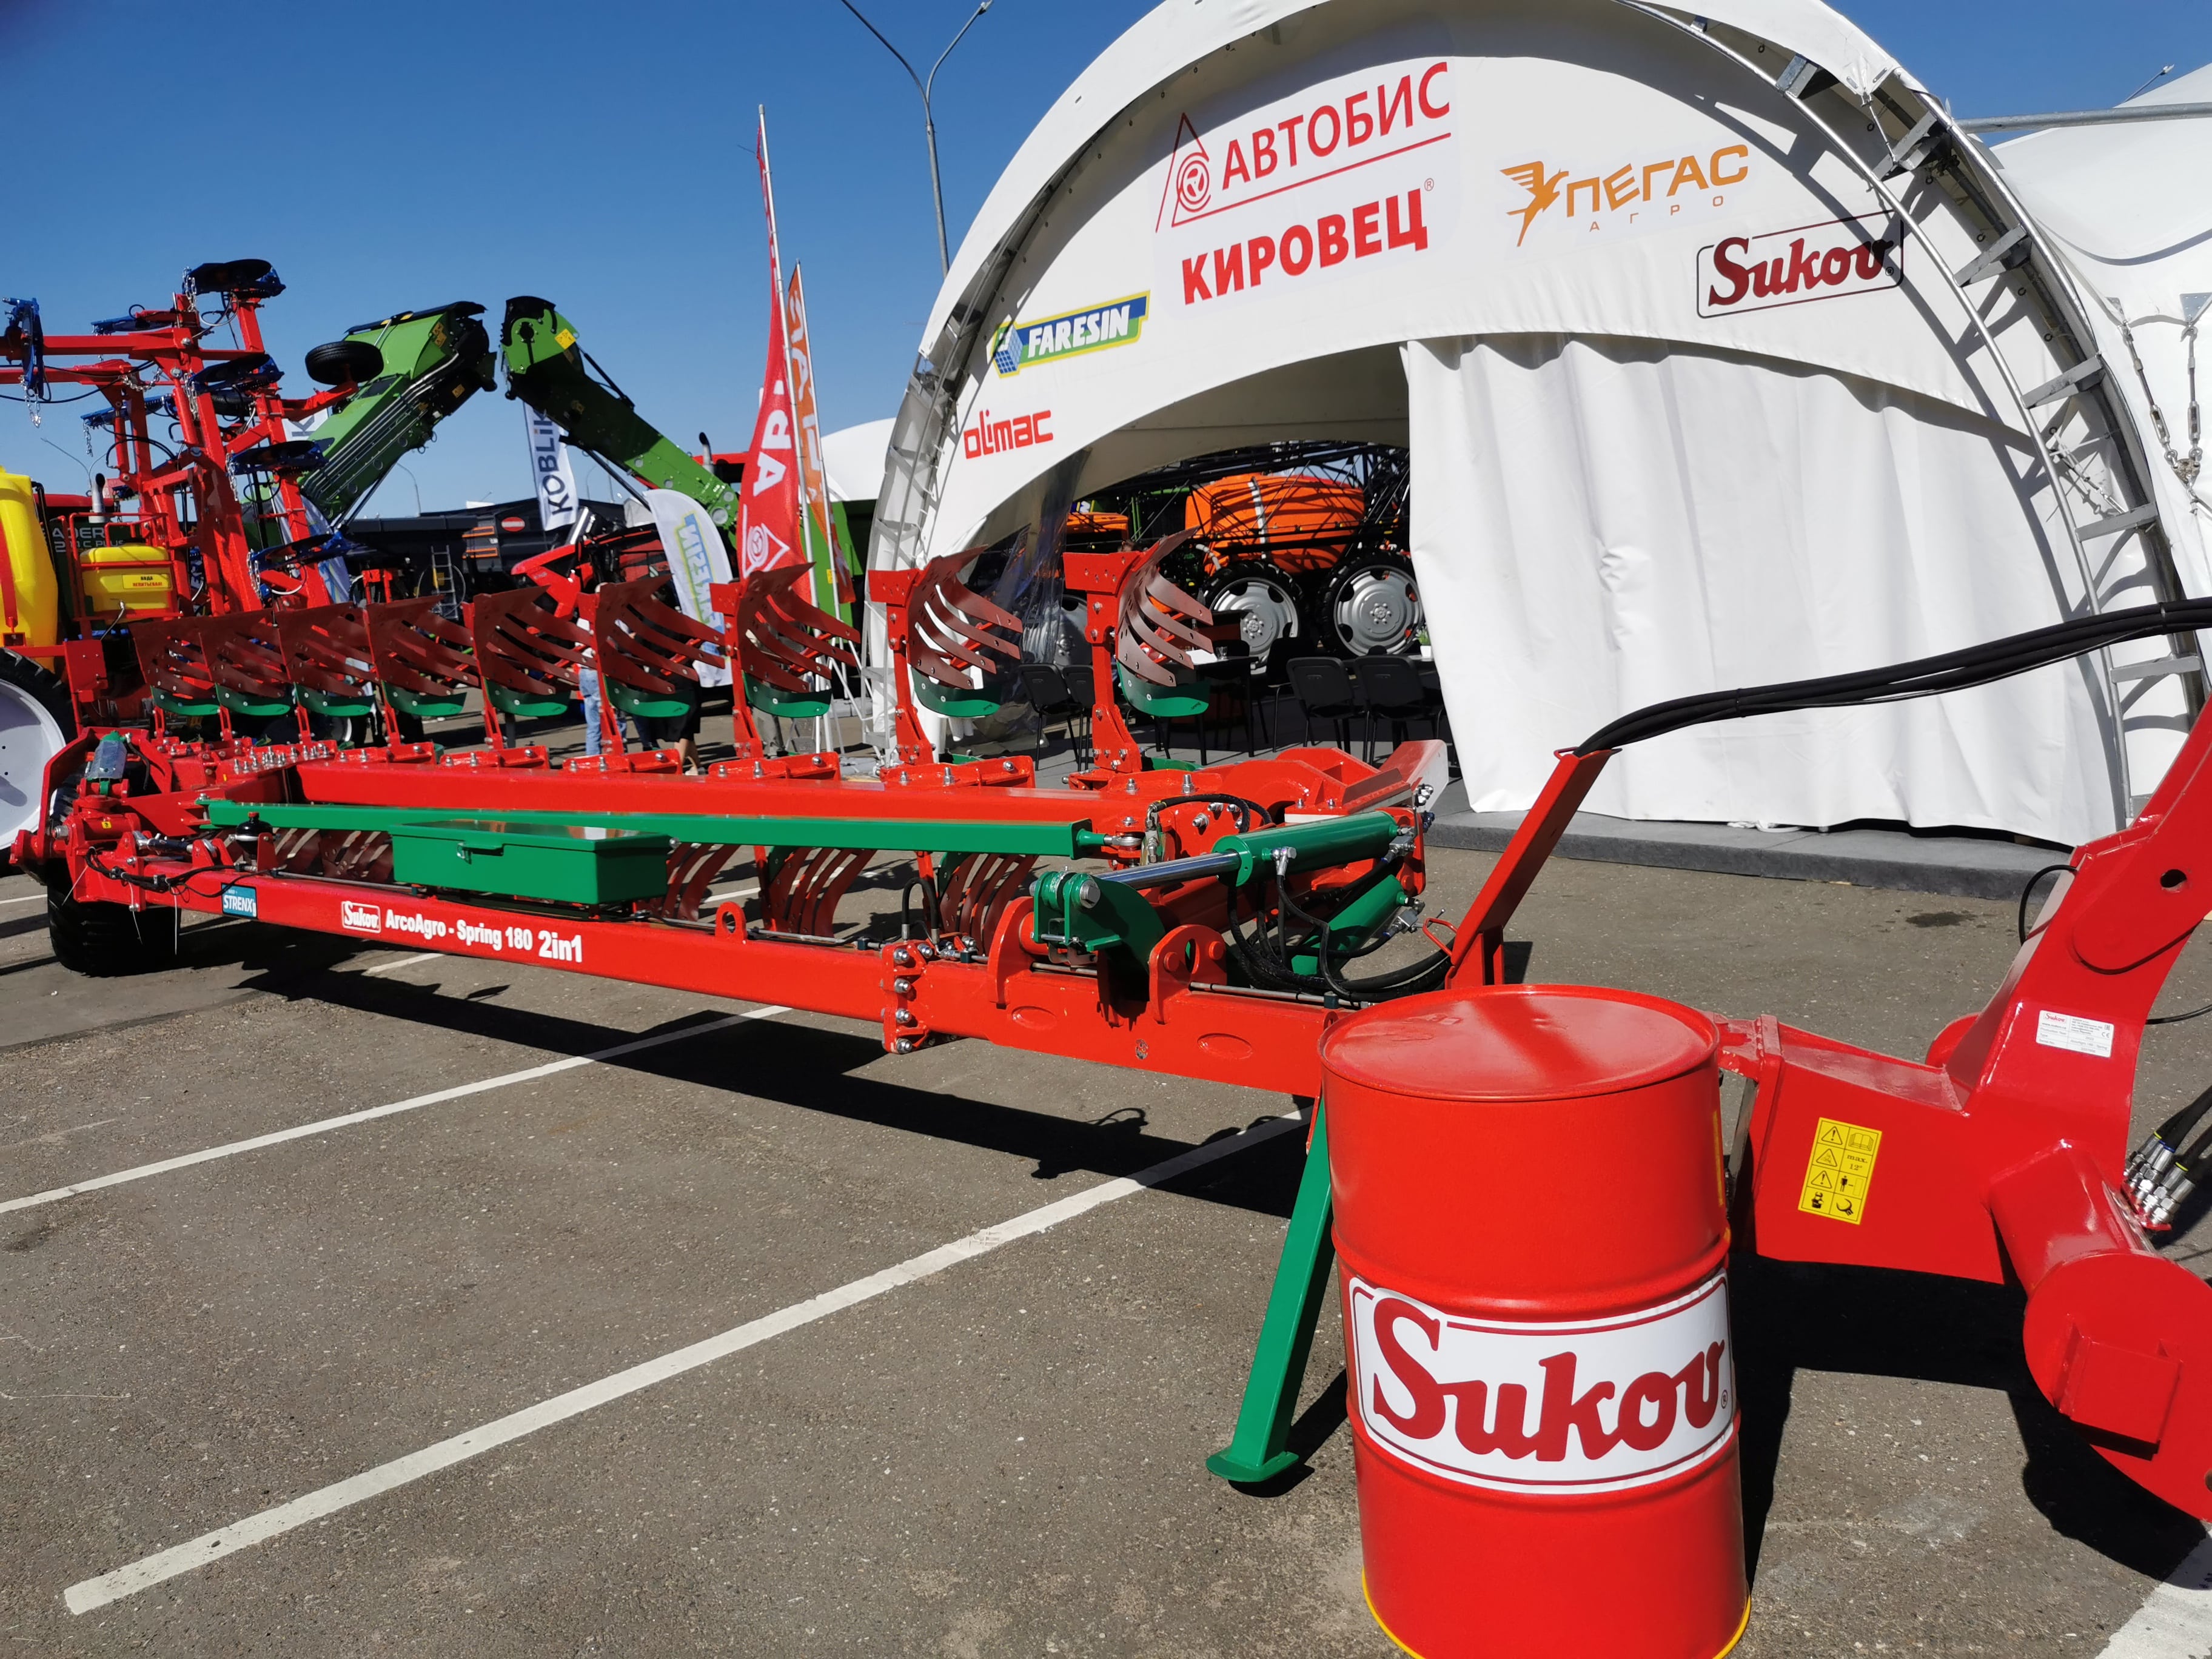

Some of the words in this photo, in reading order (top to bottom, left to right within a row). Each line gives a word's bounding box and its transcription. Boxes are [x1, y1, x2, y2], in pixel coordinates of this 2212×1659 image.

[1222, 61, 1450, 190] АВТОБИС
[1566, 144, 1749, 218] ПЕГАС
[1590, 195, 1724, 232] АГРО
[1182, 188, 1429, 306] КИРОВЕЦ
[1708, 236, 1894, 307] Sukov
[1027, 304, 1131, 359] FARESIN
[964, 409, 1054, 460] olimac
[224, 894, 252, 913] STRENX
[343, 900, 379, 929] Sukov
[386, 909, 446, 940] ArcoAgro
[457, 919, 502, 951] Spring
[505, 926, 532, 951] 180
[538, 930, 583, 963] 2in1
[1846, 1155, 1868, 1164] max.
[1373, 1297, 1725, 1462] Sukov
